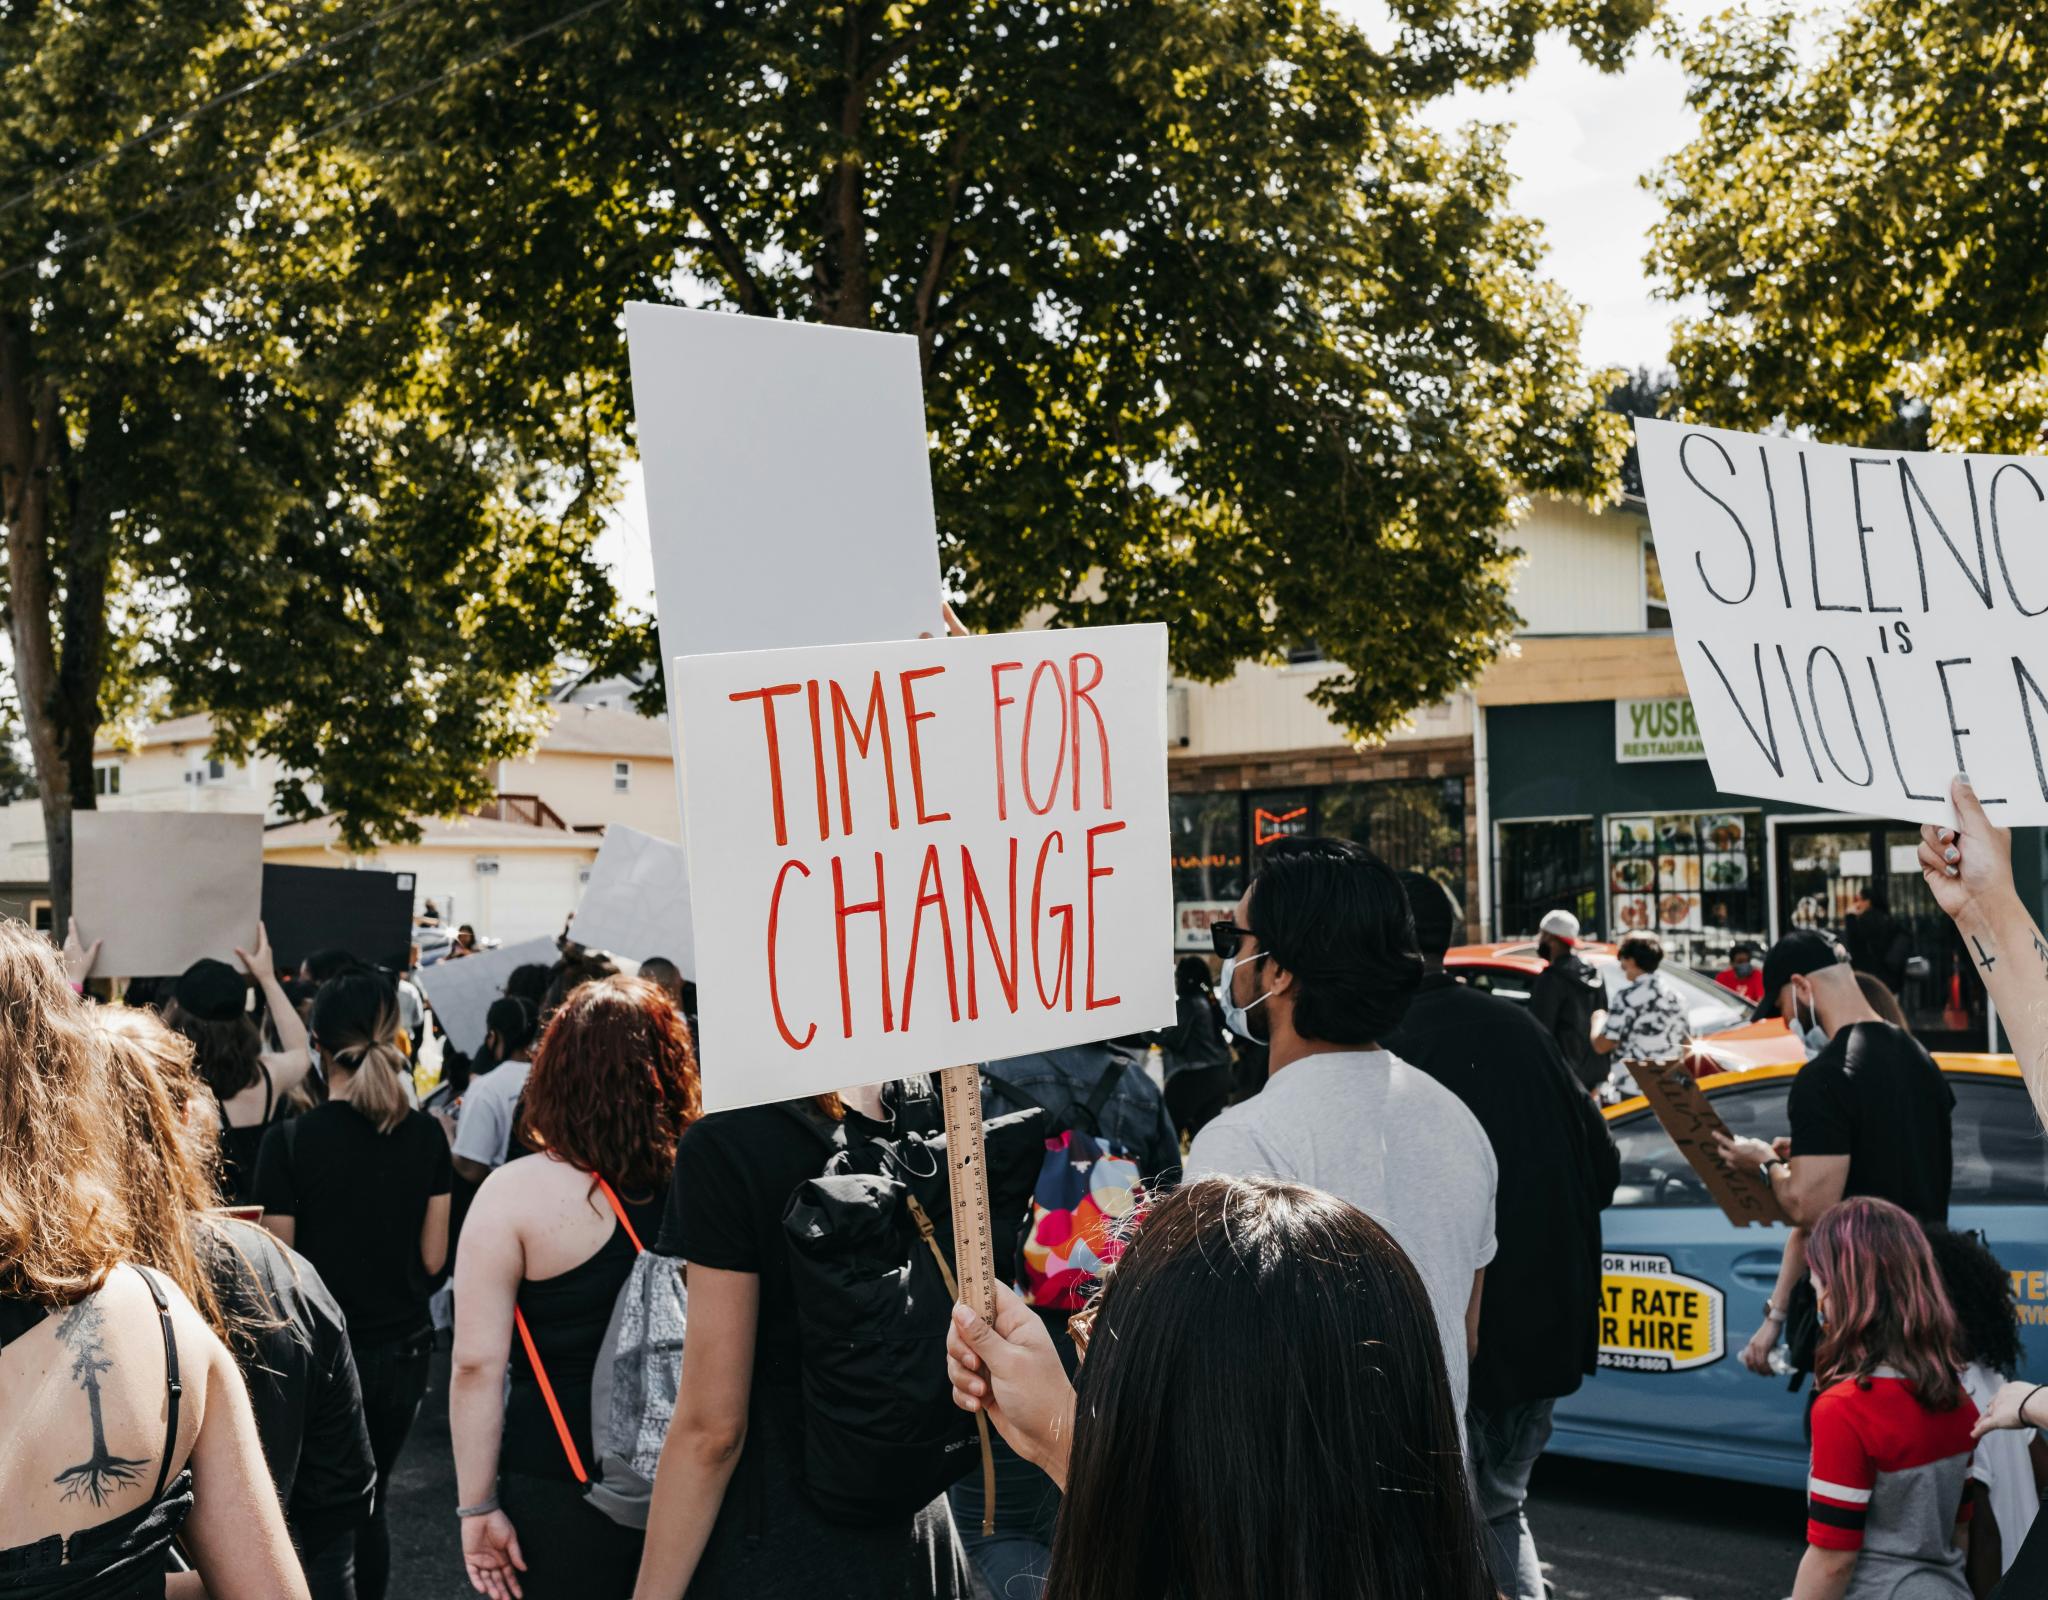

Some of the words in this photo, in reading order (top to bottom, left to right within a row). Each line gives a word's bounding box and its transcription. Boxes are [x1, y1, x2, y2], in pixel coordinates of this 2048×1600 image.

[1680, 433, 2048, 617] SILENC
[1879, 621, 1913, 654] IS
[728, 666, 951, 847] TIME
[991, 652, 1113, 821] FOR
[767, 821, 1127, 1050] CHANGE
[967, 1076, 973, 1086] 10
[968, 1092, 974, 1101] 11
[969, 1107, 975, 1116] 12
[970, 1122, 977, 1131] 13
[971, 1137, 978, 1146] 14
[973, 1152, 979, 1161] 15
[974, 1167, 980, 1176] 16
[975, 1182, 982, 1191] 17
[976, 1197, 983, 1206] 18
[977, 1212, 984, 1221] 19
[978, 1226, 985, 1236] 20
[980, 1241, 986, 1251] 21
[981, 1256, 987, 1266] 22
[1630, 1260, 1668, 1274] HIRE
[982, 1271, 989, 1281] 23
[983, 1285, 990, 1296] 24
[1632, 1288, 1698, 1319] RATE
[1629, 1319, 1693, 1351] HIRE
